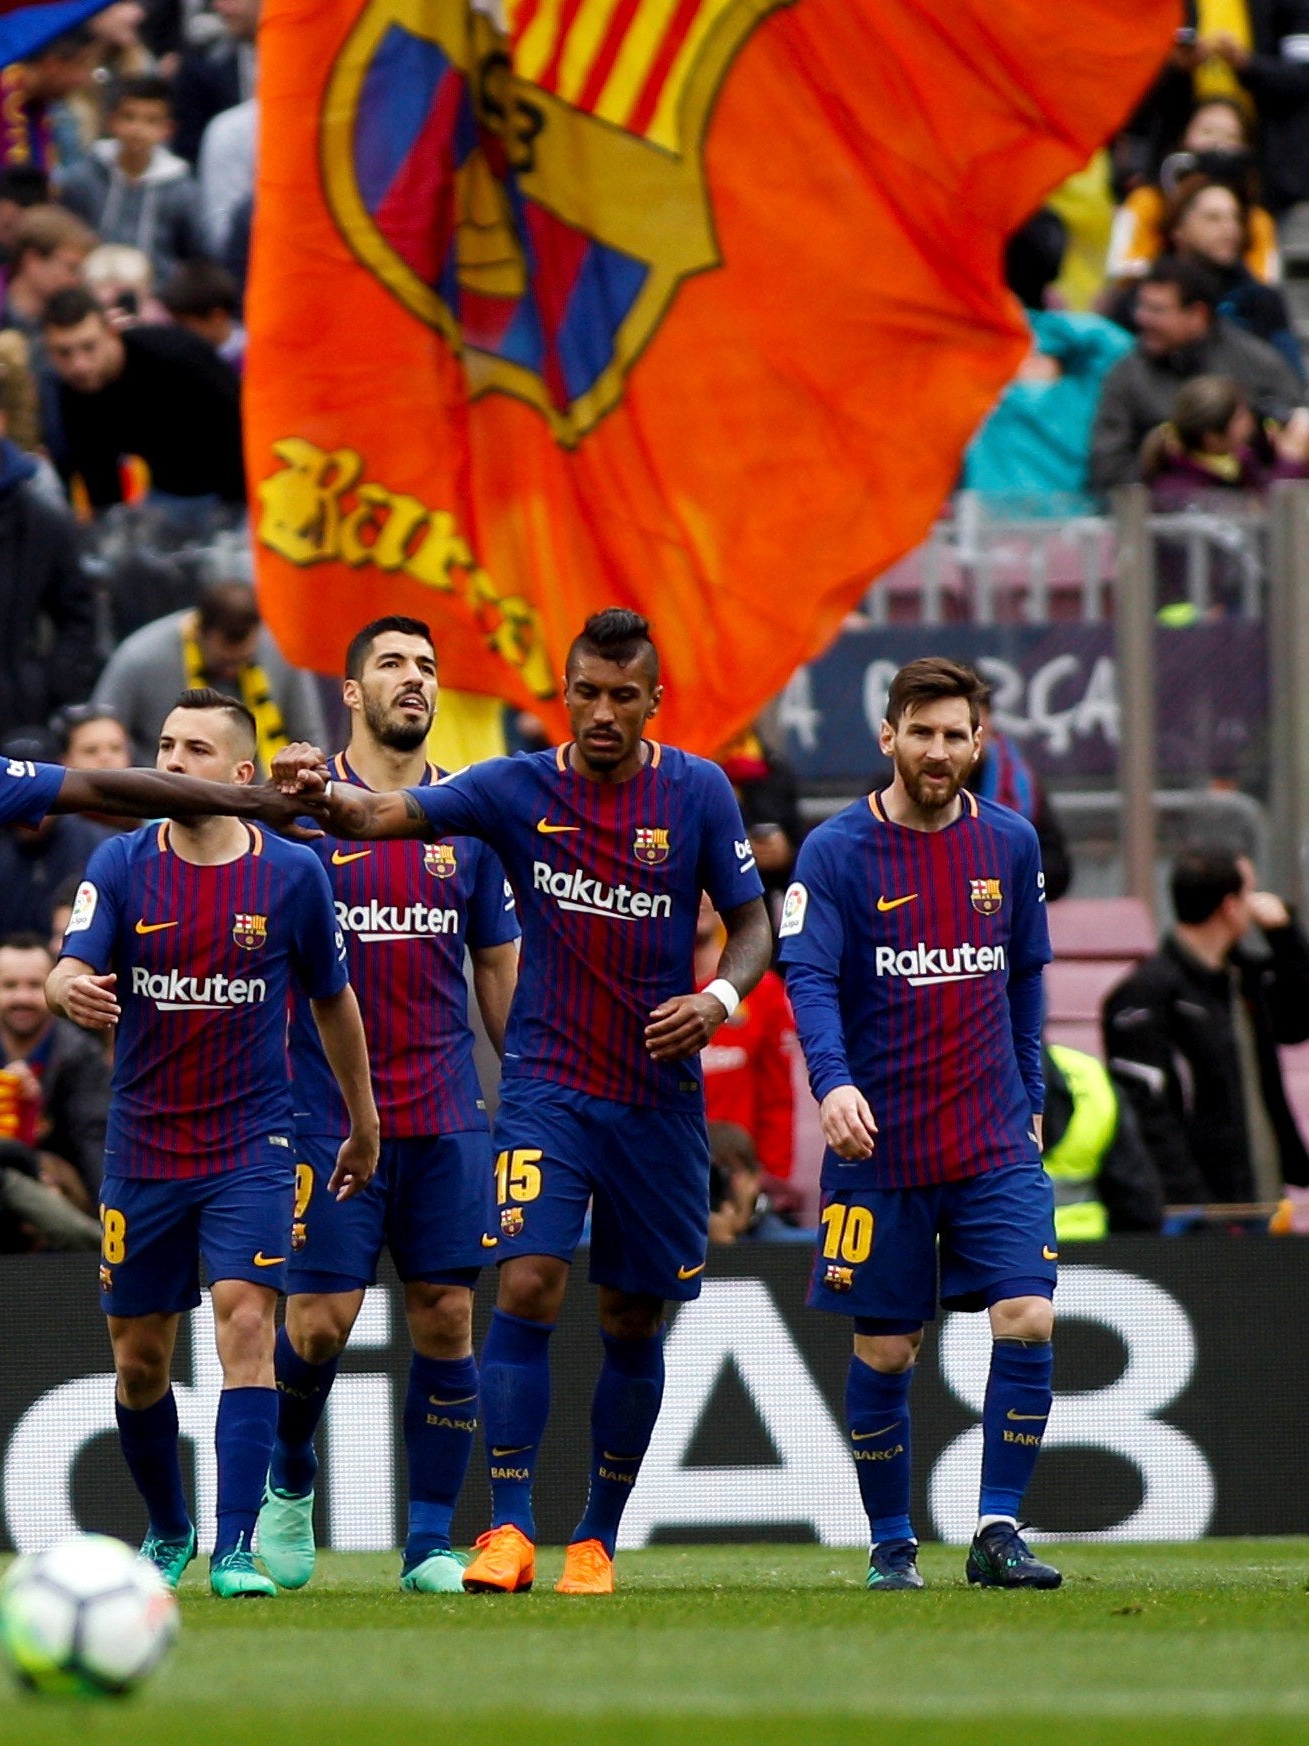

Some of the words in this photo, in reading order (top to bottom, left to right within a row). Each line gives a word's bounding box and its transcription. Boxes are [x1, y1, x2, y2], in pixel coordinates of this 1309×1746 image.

[533, 861, 672, 918] Rakuten
[334, 899, 458, 934] Rakuten
[875, 942, 1005, 977] Rakuten
[132, 966, 266, 1004] Rakuten
[494, 1149, 542, 1205] 15
[821, 1203, 874, 1263] 10
[616, 1265, 1216, 1549] A8
[491, 1467, 529, 1480] BARÇA
